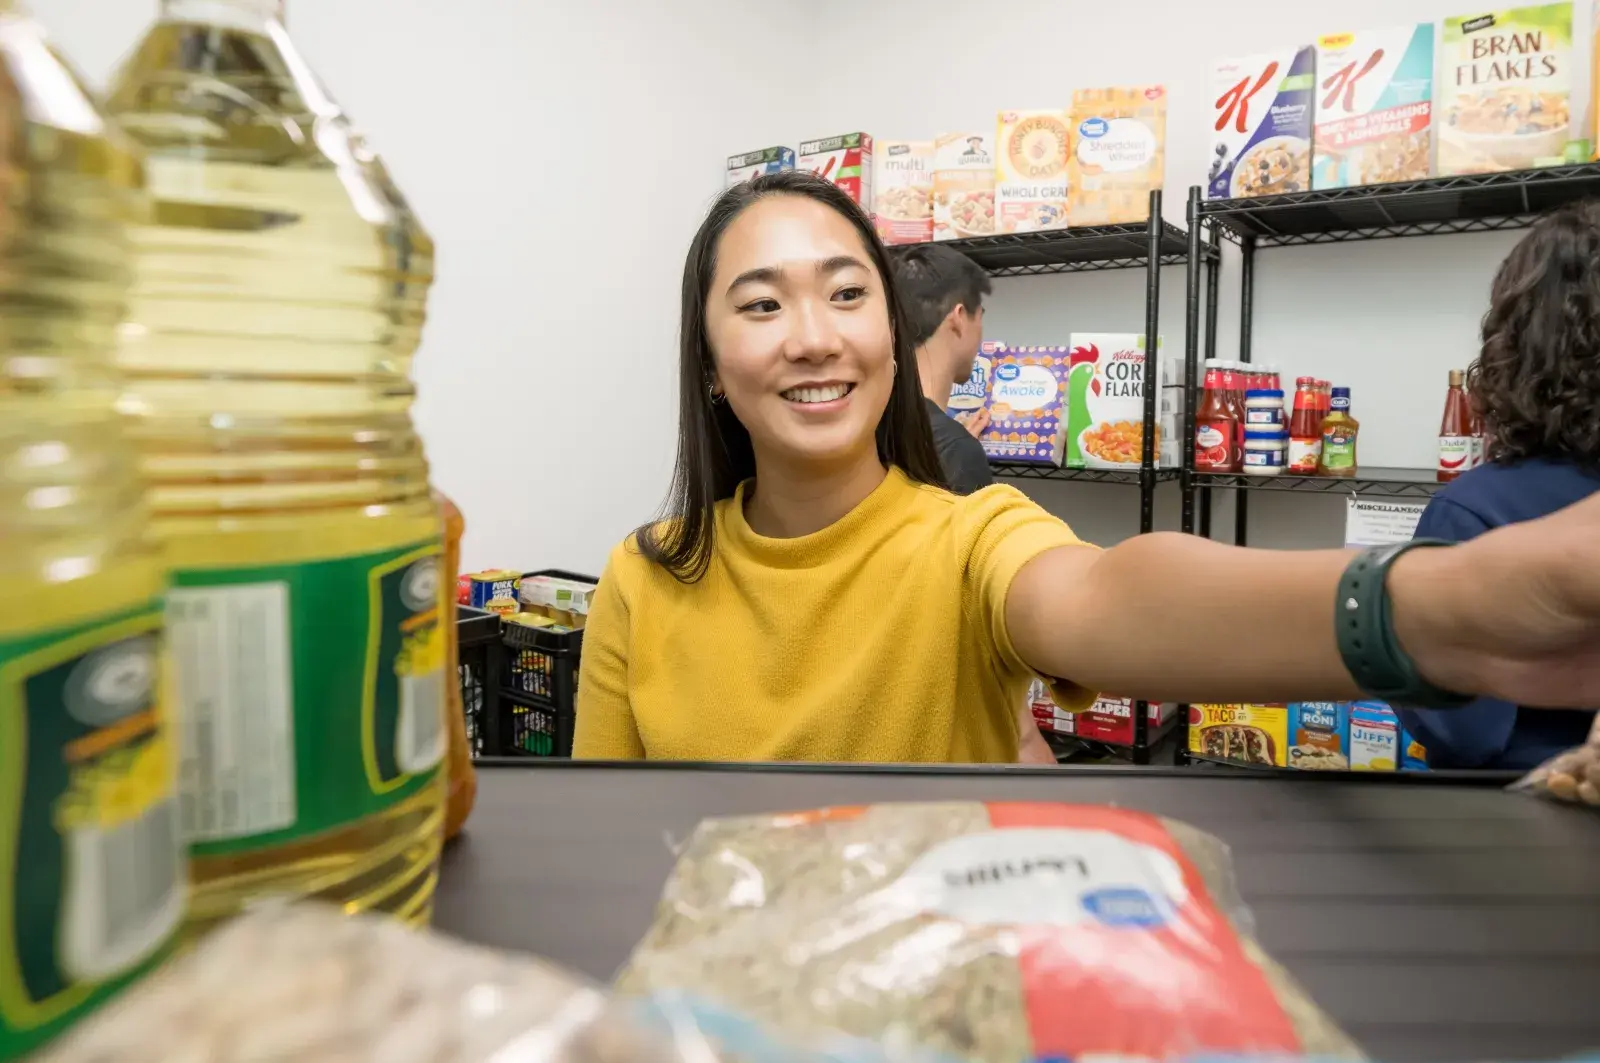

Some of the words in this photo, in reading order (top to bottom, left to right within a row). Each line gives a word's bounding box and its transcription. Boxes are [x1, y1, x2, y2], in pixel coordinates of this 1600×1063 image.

[1472, 31, 1541, 59] BRAN
[1455, 55, 1556, 86] FLAKES
[1321, 49, 1384, 112] K
[1215, 61, 1279, 133] K
[800, 142, 820, 155] FREE
[728, 157, 746, 168] FREE
[885, 158, 924, 171] multi
[1001, 186, 1037, 198] WHOLE
[1105, 362, 1146, 381] COR
[999, 384, 1045, 396] Awake
[492, 580, 513, 590] PORK
[1302, 702, 1333, 711] PASTA
[1208, 709, 1236, 722] TACO
[1303, 713, 1334, 726] RONI
[1353, 729, 1393, 744] JIFFY
